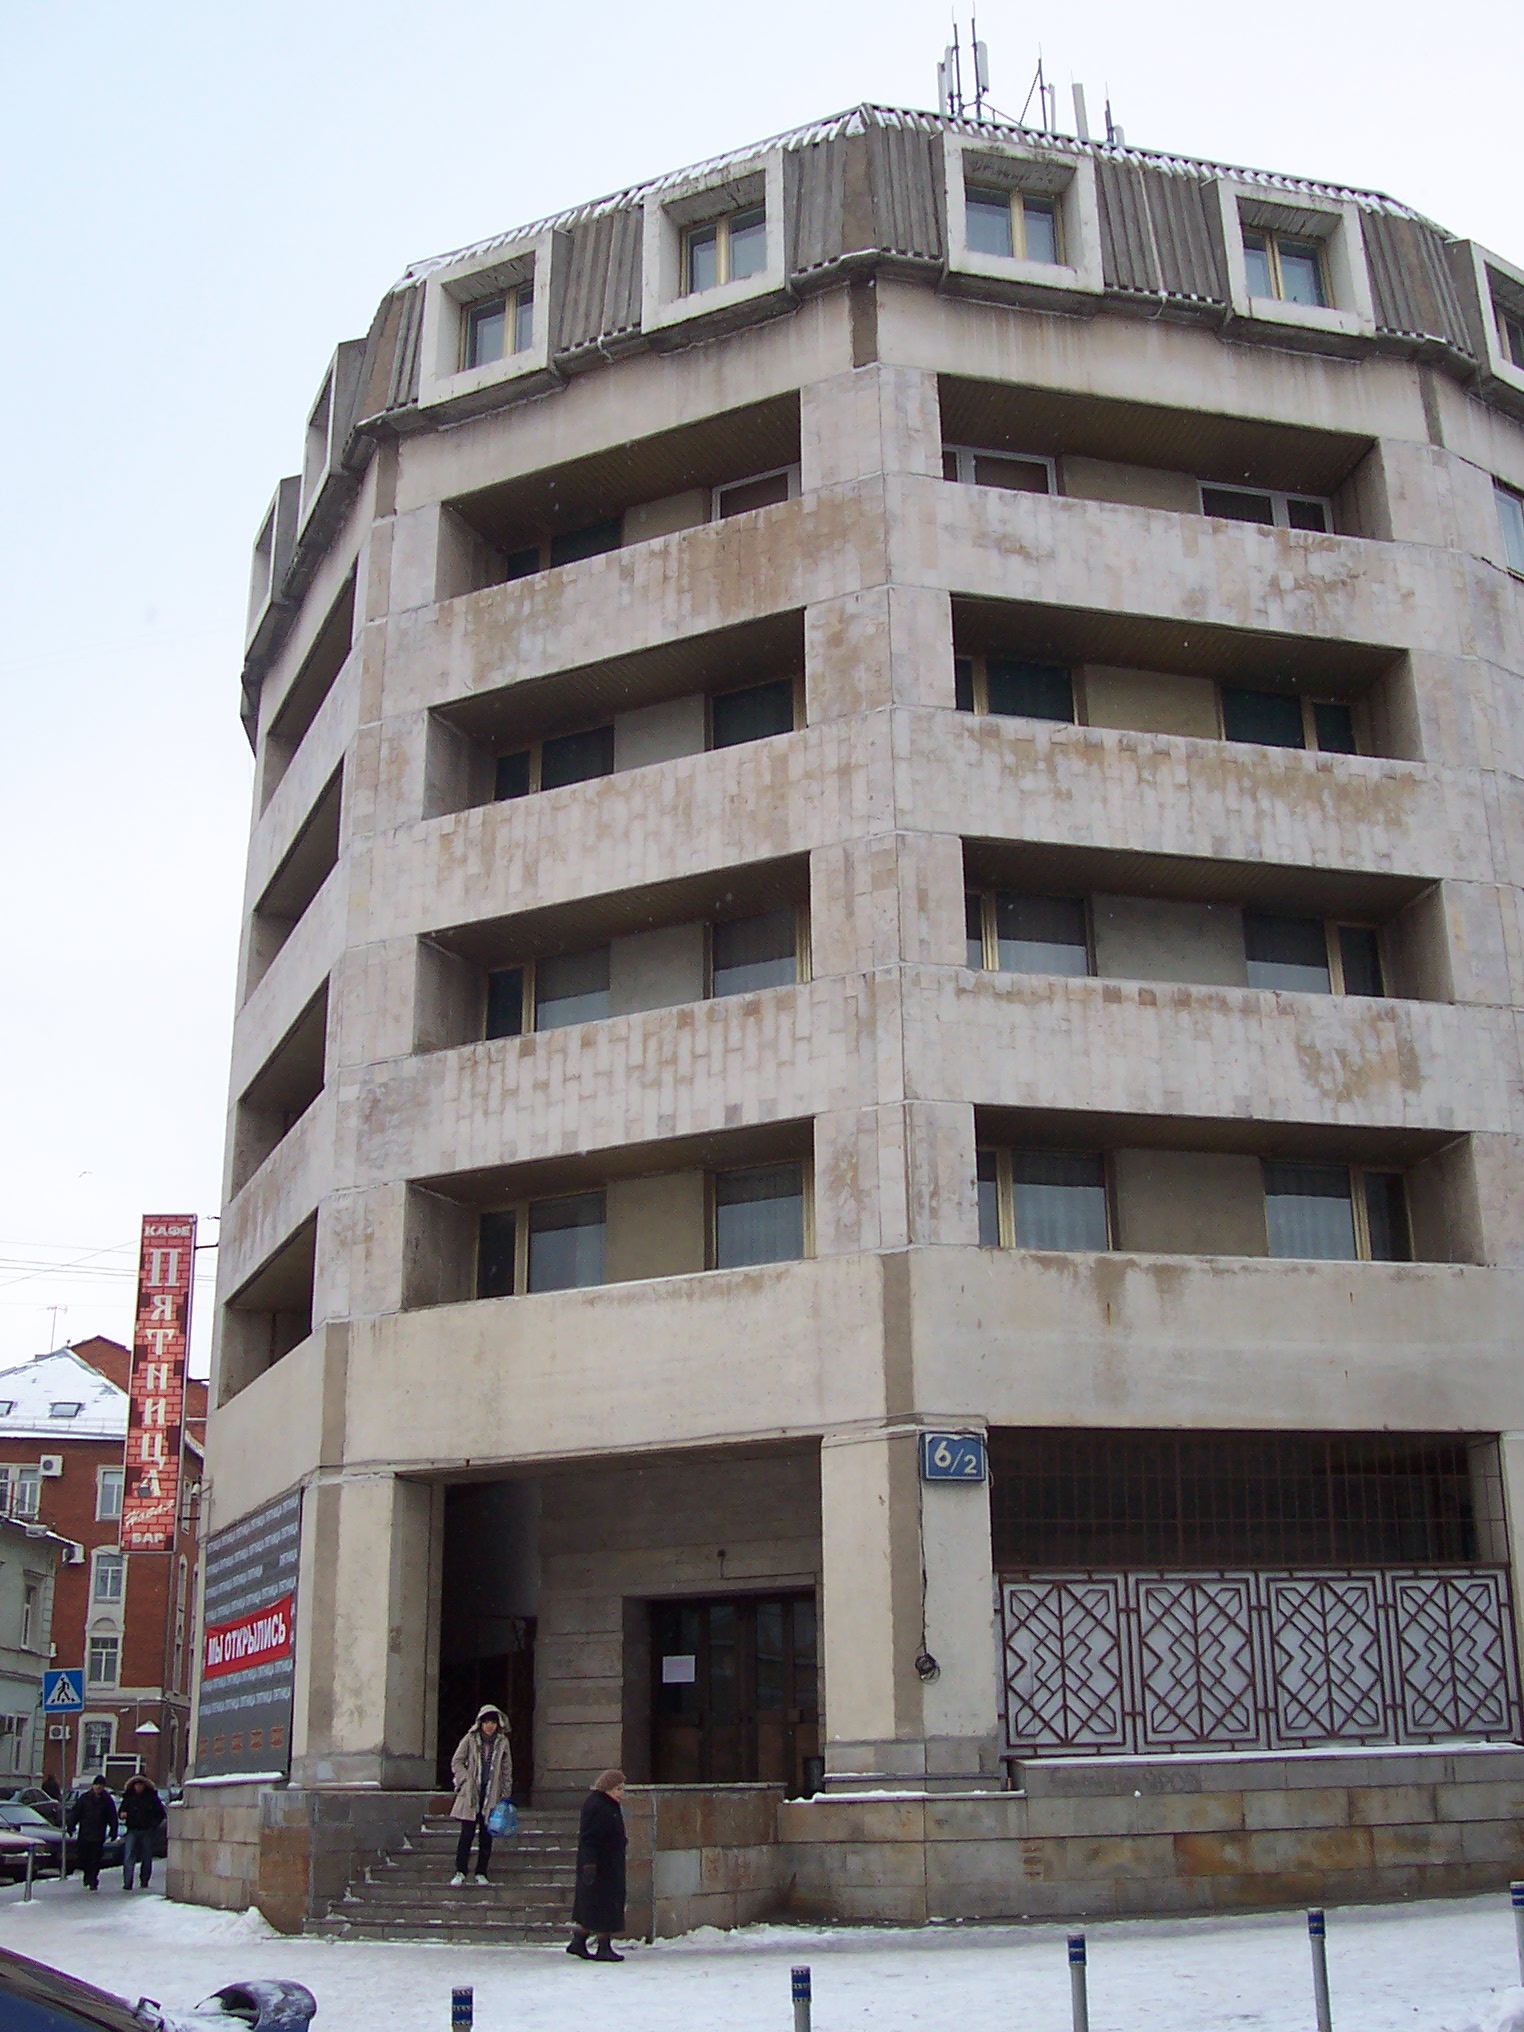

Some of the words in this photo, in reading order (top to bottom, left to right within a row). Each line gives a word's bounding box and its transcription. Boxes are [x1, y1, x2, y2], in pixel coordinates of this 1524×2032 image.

[144, 1225, 191, 1237] КАФЕ
[136, 1248, 182, 1496] ПЯТНИЦА
[934, 1440, 977, 1474] 6/2
[131, 1532, 165, 1544] БАР
[207, 1634, 224, 1667] МЫ
[224, 1612, 286, 1661] ОТКРЫЛИСЬ
